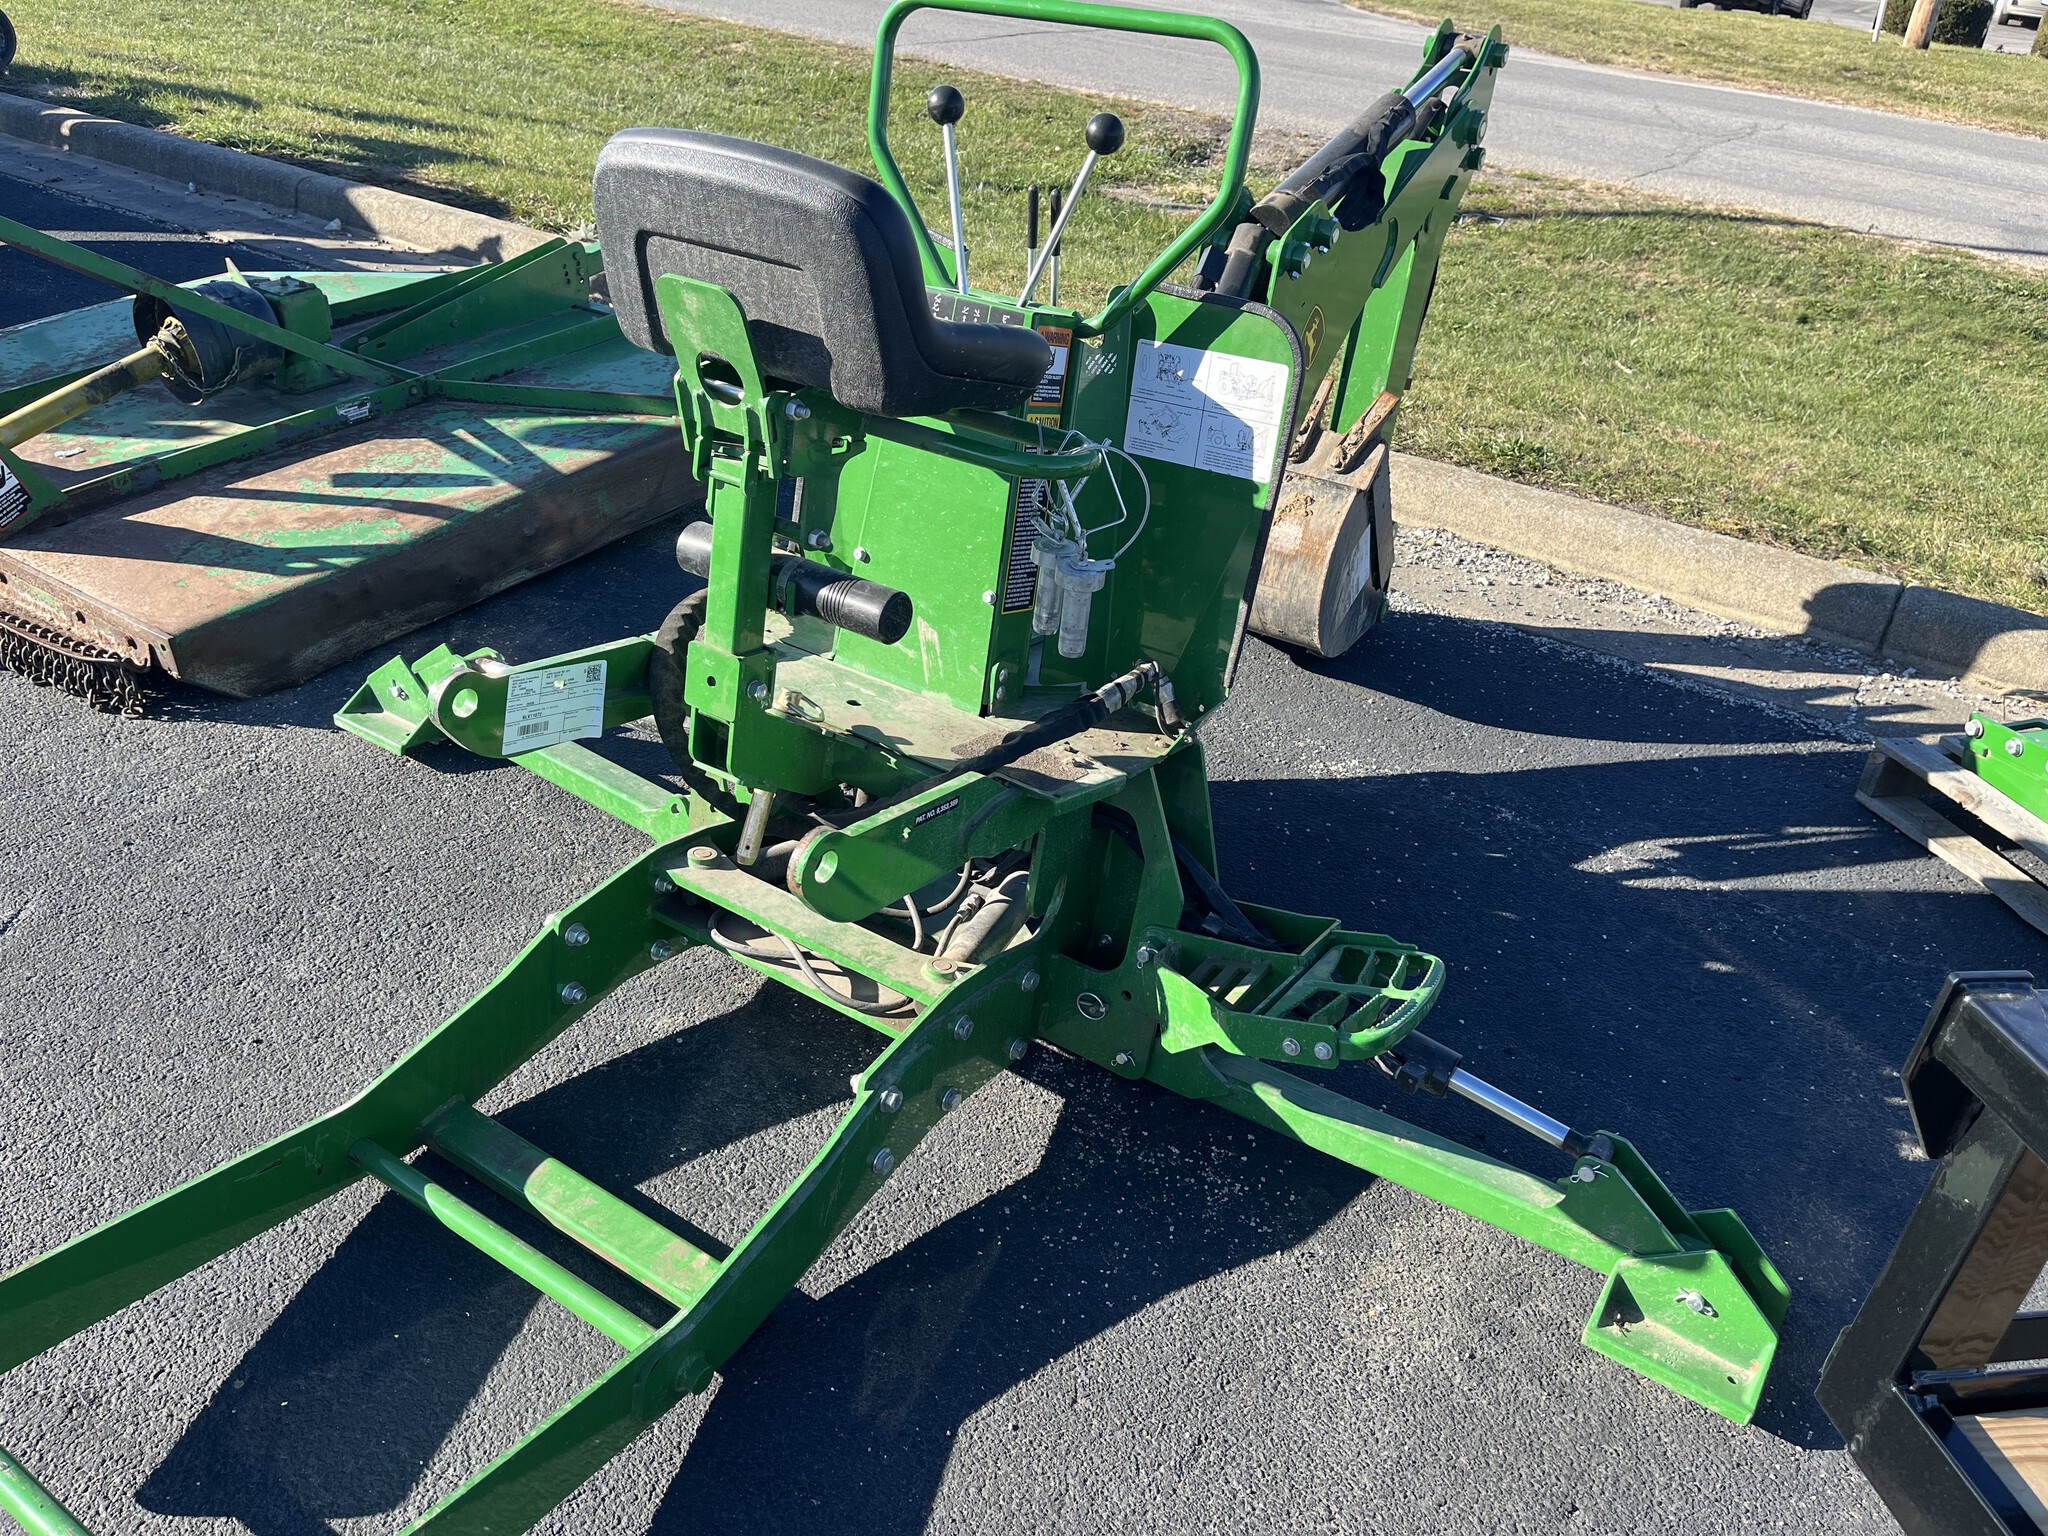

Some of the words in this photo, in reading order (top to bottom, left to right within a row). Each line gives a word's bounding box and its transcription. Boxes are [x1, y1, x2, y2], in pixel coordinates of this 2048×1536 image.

[1045, 331, 1070, 345] WARNING
[1035, 417, 1060, 429] CAUTION
[915, 813, 927, 825] PAT.
